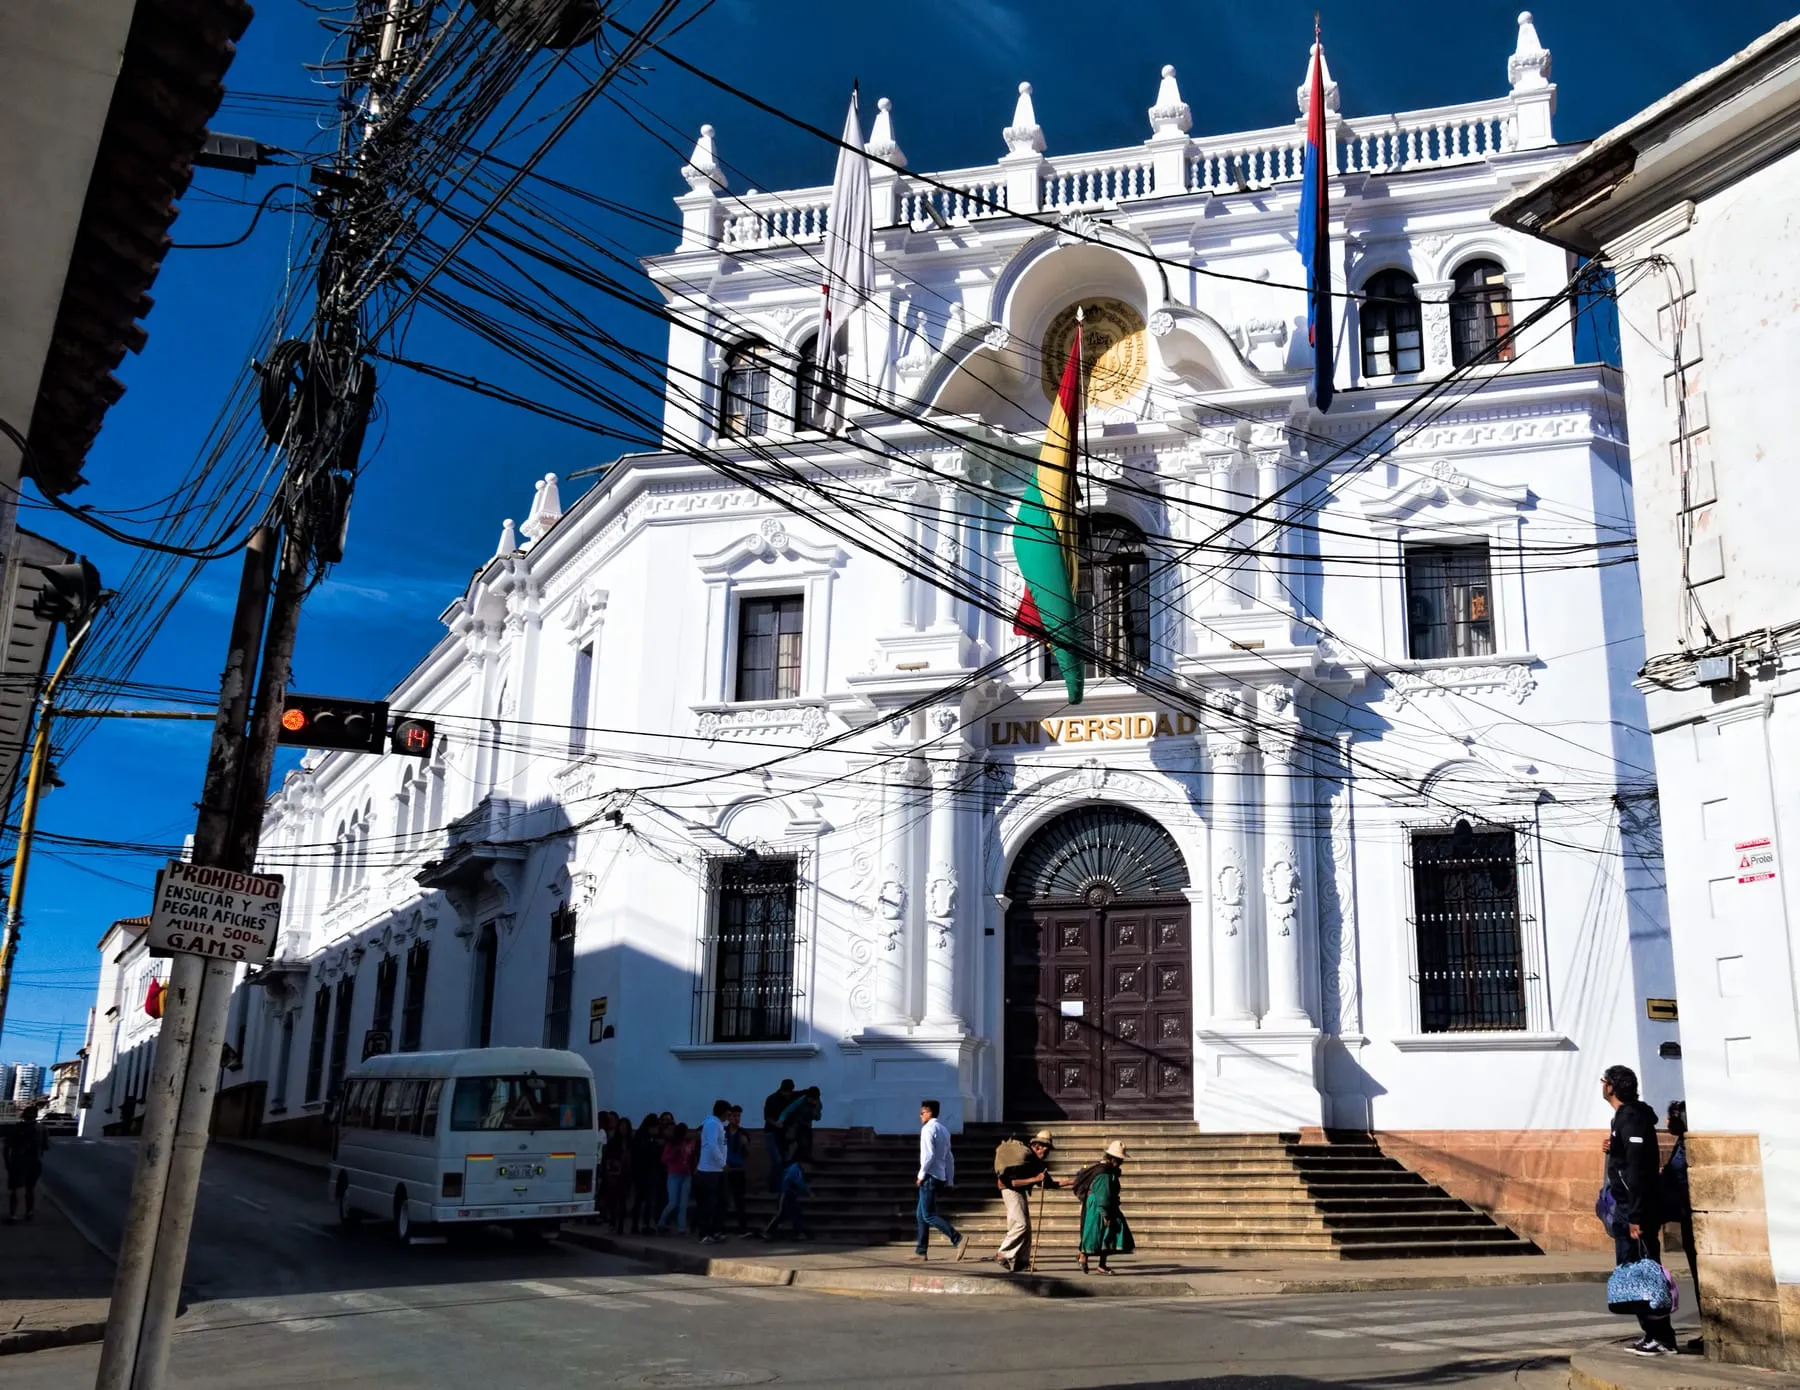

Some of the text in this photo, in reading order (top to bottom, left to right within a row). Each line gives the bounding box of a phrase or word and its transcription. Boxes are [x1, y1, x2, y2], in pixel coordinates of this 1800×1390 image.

[408, 728, 426, 748] 14
[991, 712, 1198, 745] UNIVERSIDAD
[169, 863, 280, 899] PROHIBIDO
[165, 885, 234, 909] ENSUCIAR
[242, 899, 252, 912] Y
[162, 900, 207, 919] PEGAR
[212, 909, 267, 931] AFICHES
[166, 918, 214, 936] MULTA
